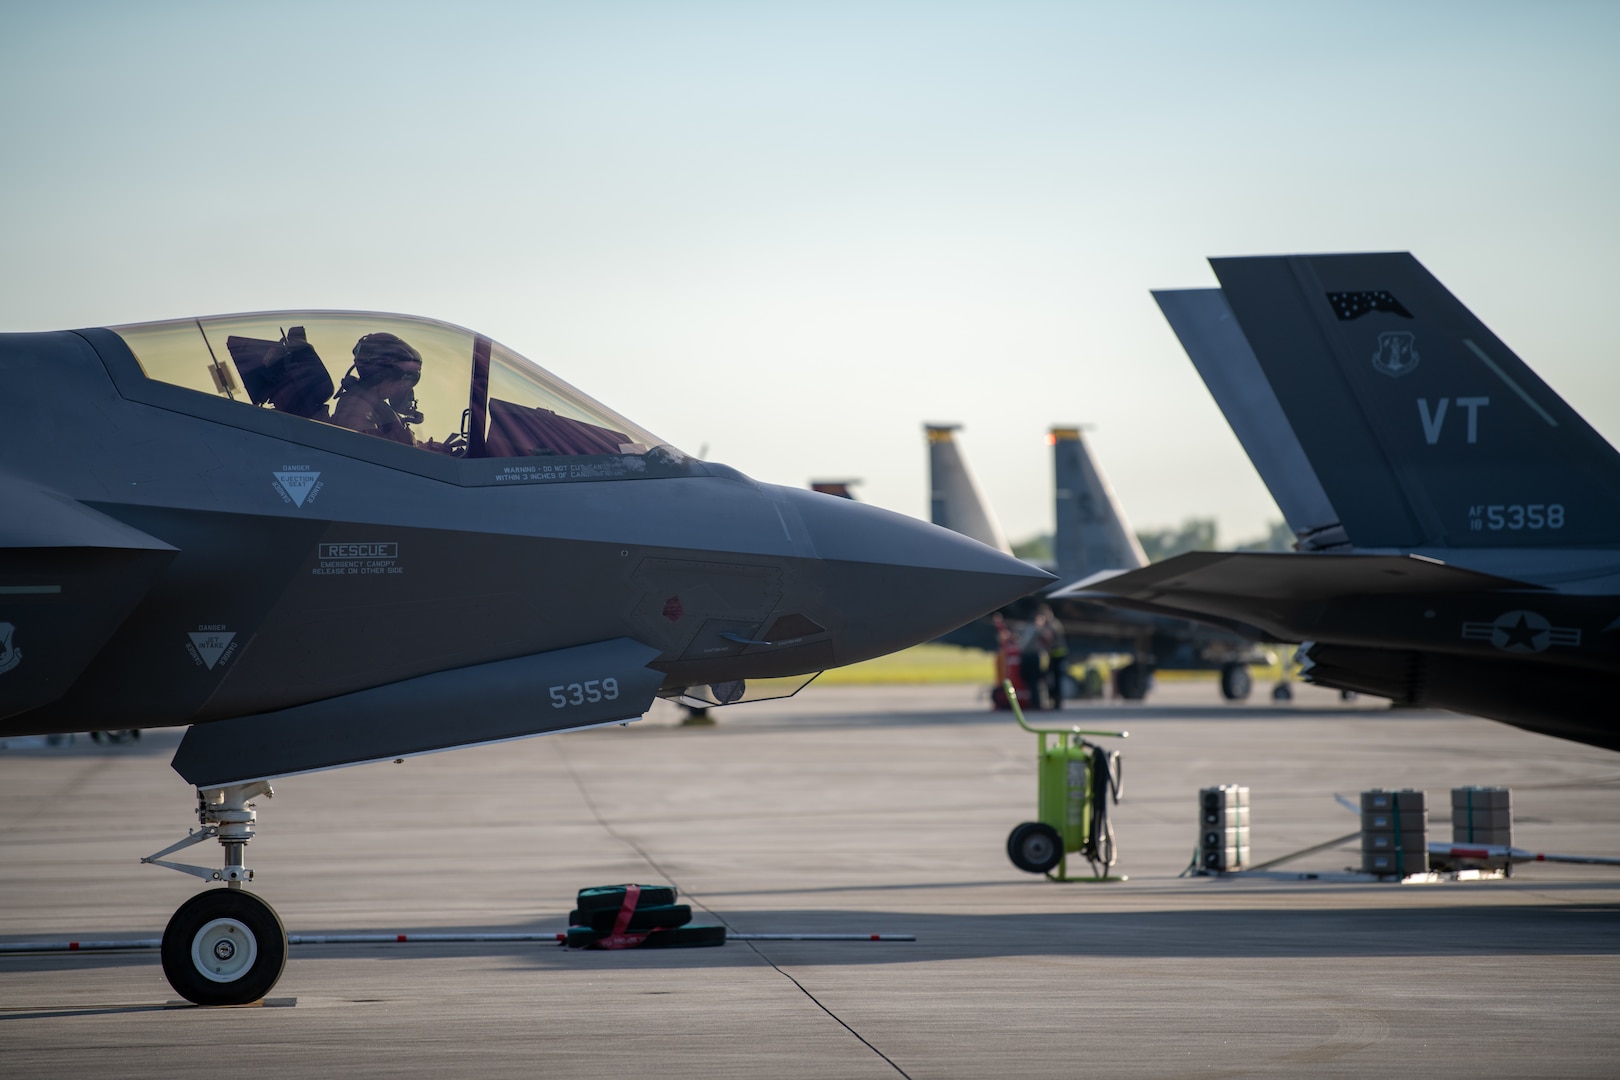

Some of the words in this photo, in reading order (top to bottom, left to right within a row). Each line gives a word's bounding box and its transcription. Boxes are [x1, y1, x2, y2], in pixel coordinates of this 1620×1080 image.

[1416, 396, 1490, 445] VT
[530, 472, 556, 480] INCHES
[272, 480, 291, 504] DANGER
[307, 480, 324, 504] DANGER
[1468, 505, 1485, 518] AF
[1487, 503, 1565, 530] 5358
[329, 545, 388, 557] RESCUE
[185, 641, 203, 666] DANGER
[218, 642, 238, 666] DANGER
[549, 677, 619, 709] 5359
